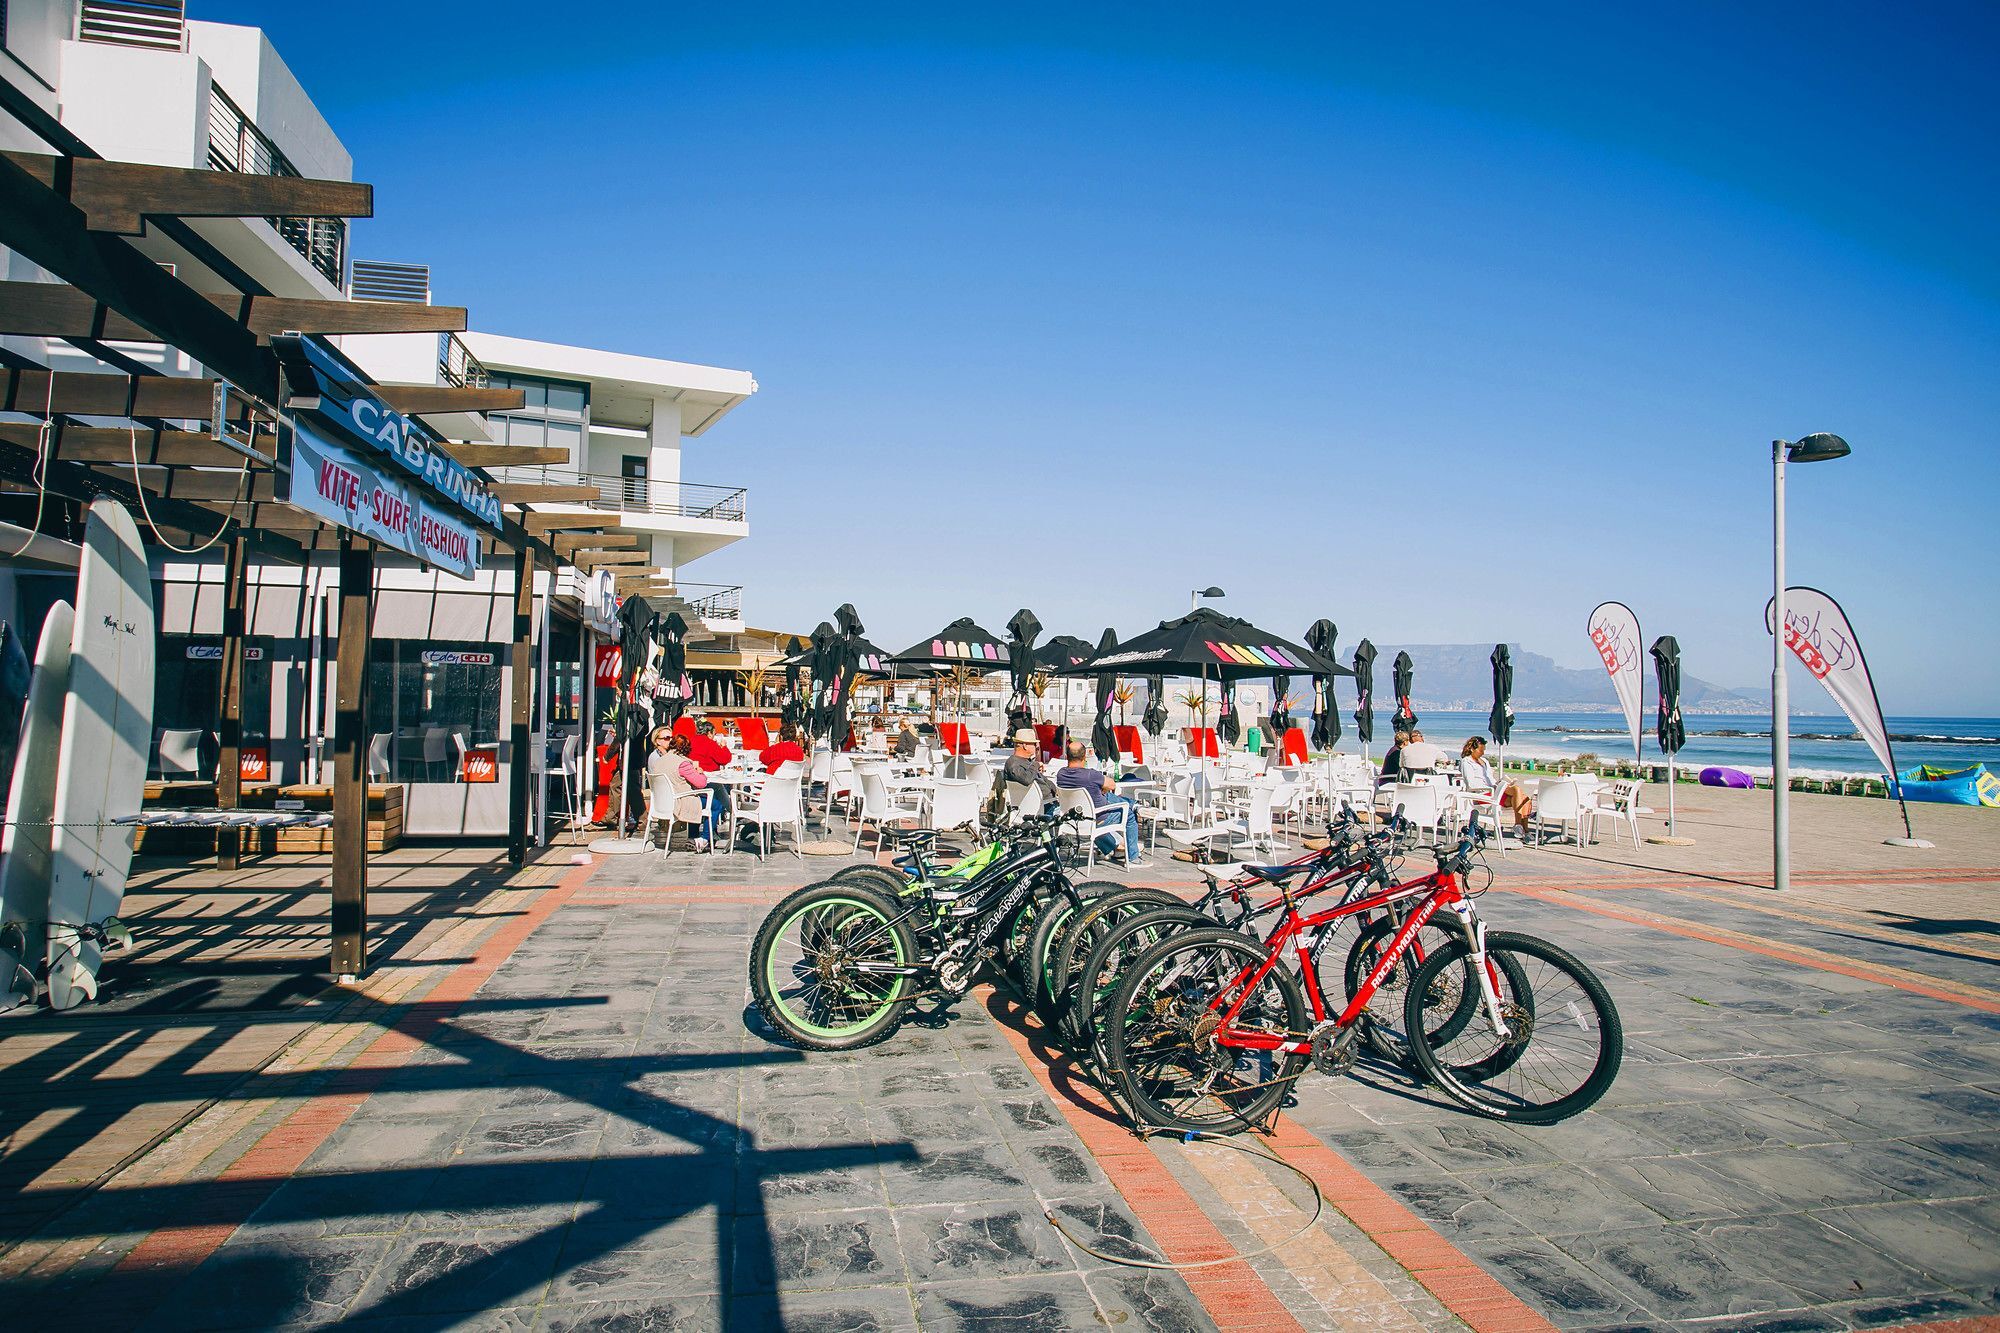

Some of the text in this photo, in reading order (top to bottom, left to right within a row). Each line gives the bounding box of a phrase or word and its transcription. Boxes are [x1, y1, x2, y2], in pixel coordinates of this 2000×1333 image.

[351, 398, 499, 524] CABRINHA
[318, 459, 469, 564] KITE SURF FASHION
[467, 756, 492, 778] illy
[1370, 897, 1437, 990] ROCKY MOUNTAIN
